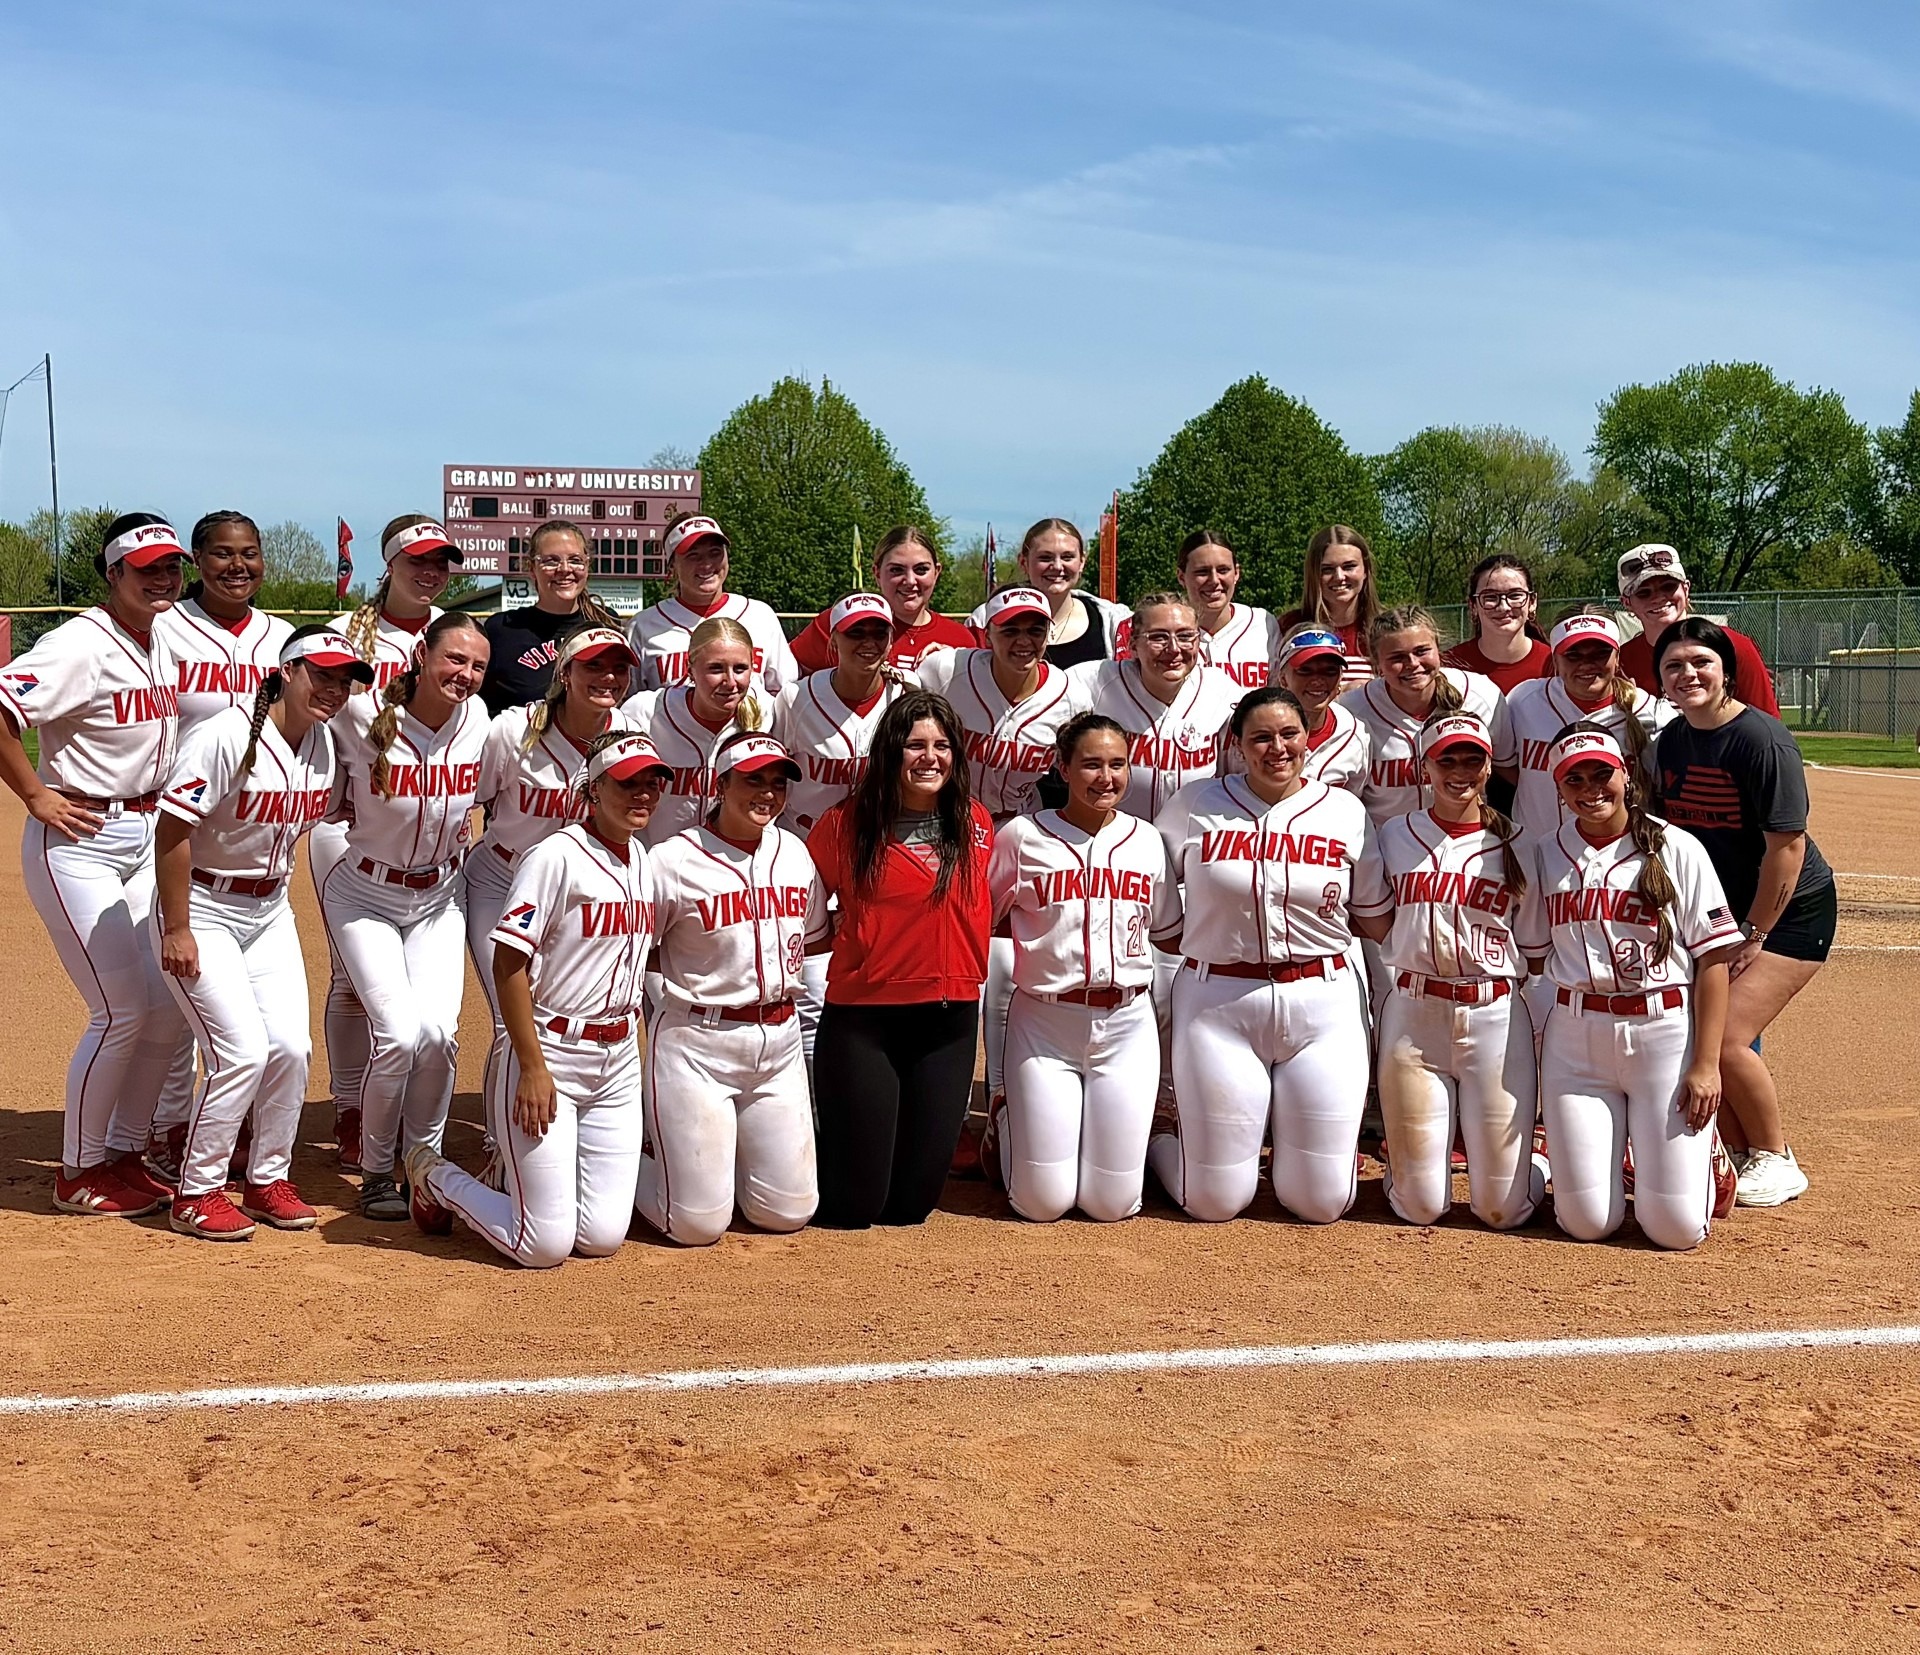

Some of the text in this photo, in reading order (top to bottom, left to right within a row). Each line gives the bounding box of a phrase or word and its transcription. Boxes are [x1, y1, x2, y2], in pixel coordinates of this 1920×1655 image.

[451, 470, 517, 488] GRAND
[581, 472, 696, 491] UNIVERSITY
[448, 507, 471, 518] BAT
[453, 496, 467, 506] AT
[502, 502, 532, 514] BALL
[550, 503, 592, 515] STRIKE
[608, 504, 633, 516] OUT
[454, 539, 506, 551] VISITOR
[512, 527, 518, 536] 1
[525, 527, 531, 536] 2
[590, 528, 597, 537] 7
[603, 529, 610, 538] 8
[617, 529, 623, 538] 9
[627, 529, 638, 538] 10
[462, 557, 499, 570] HOME
[112, 684, 179, 725] VIKIN
[235, 787, 332, 824] VIKINGS
[1201, 829, 1347, 868] VIKINGS
[1033, 867, 1151, 908] VIKINGS
[1318, 882, 1341, 919] 3
[1392, 871, 1512, 917] VIKINGS
[694, 885, 809, 932] VIKINGS
[1545, 887, 1657, 928] VIKINGS
[1471, 924, 1510, 968] 15
